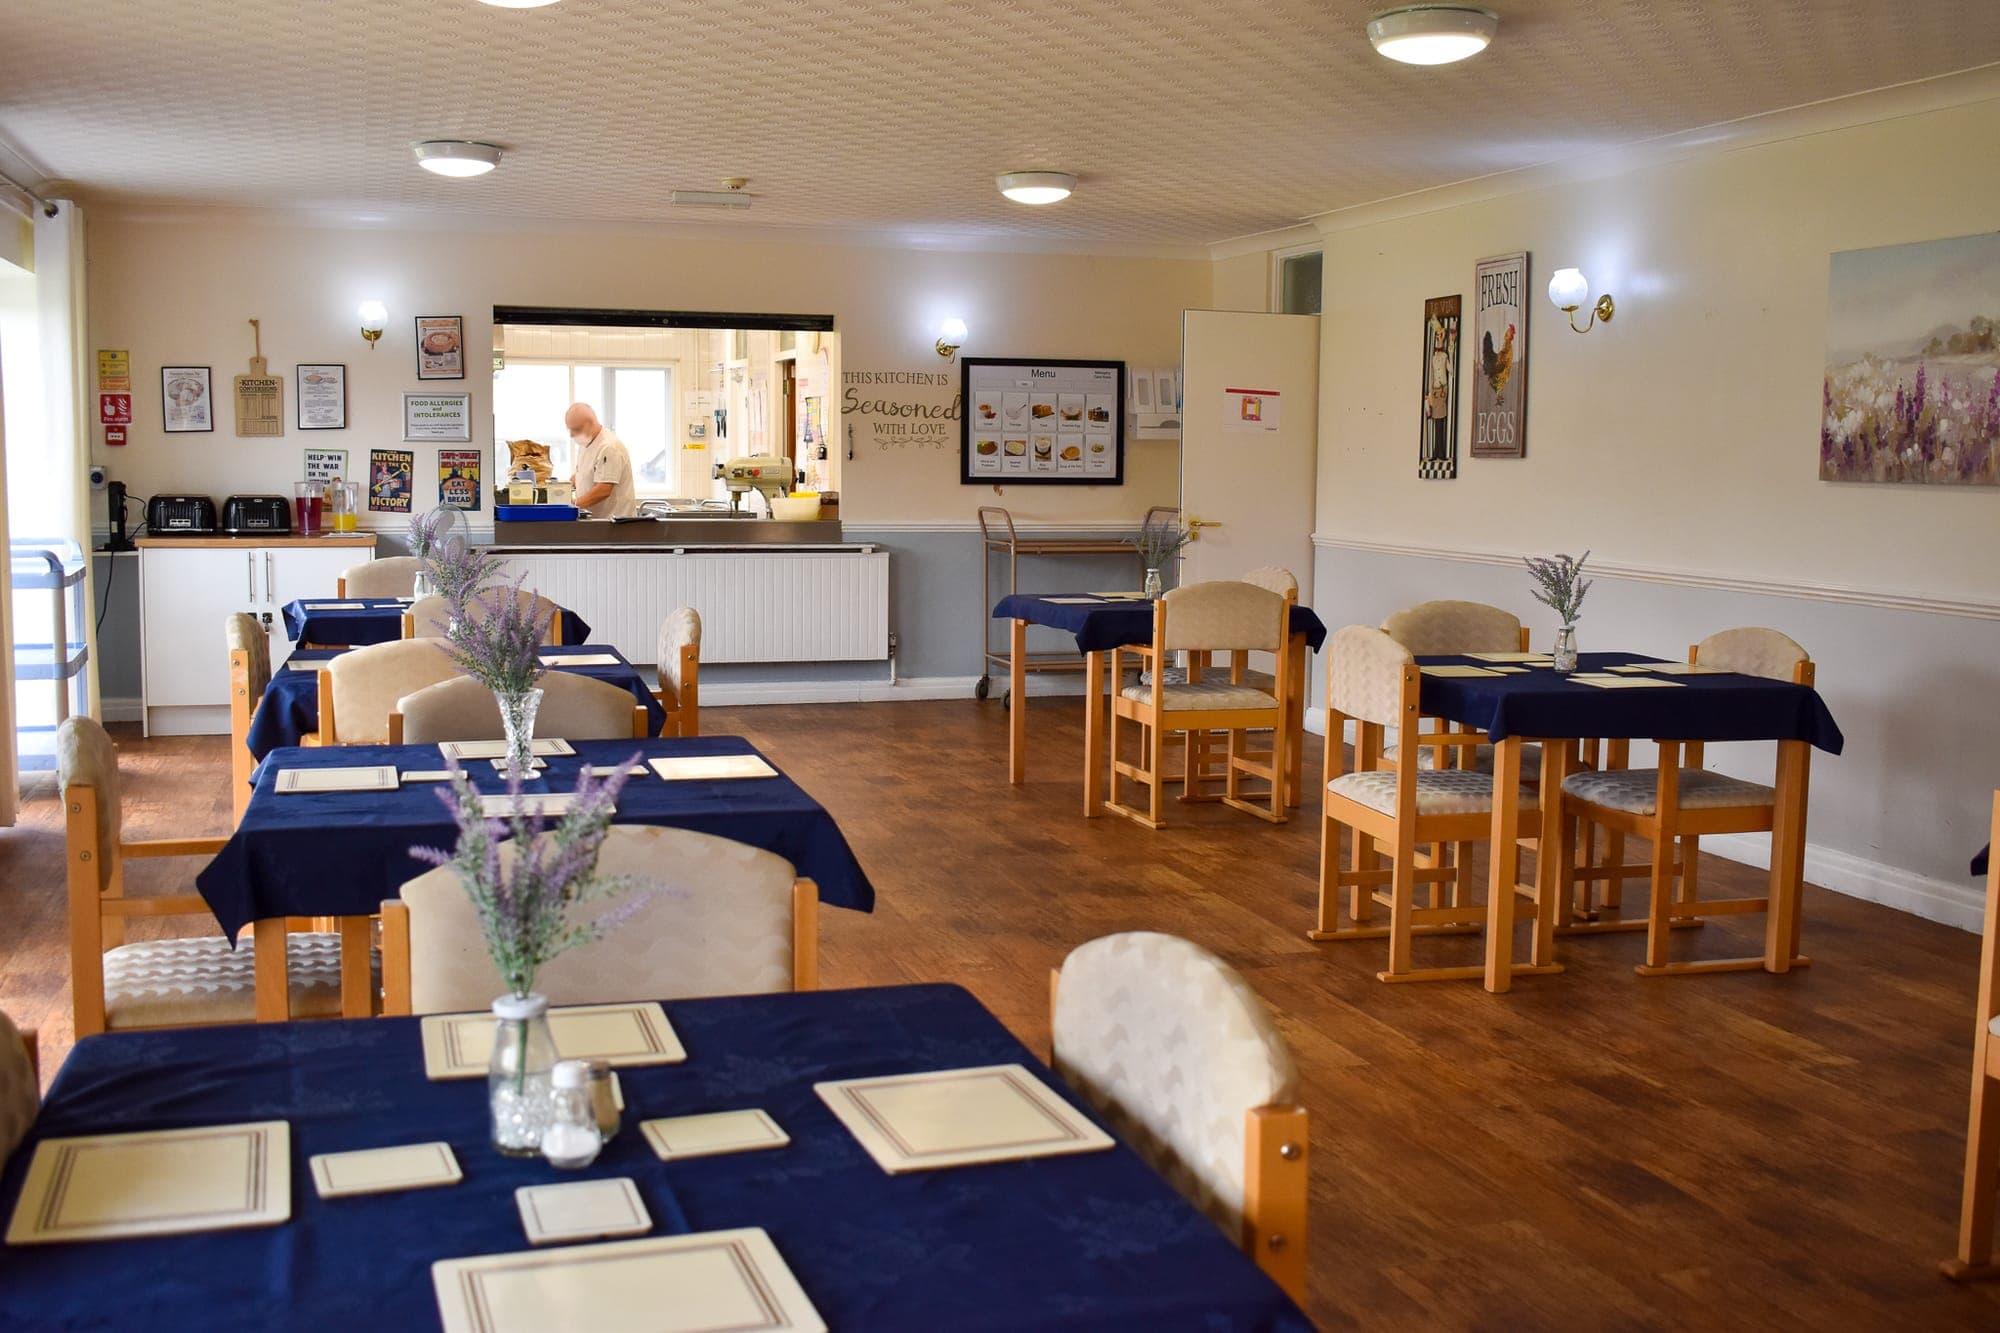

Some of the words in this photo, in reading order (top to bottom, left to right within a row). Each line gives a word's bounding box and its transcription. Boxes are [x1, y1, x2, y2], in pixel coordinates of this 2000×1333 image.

[1480, 270, 1518, 312] FRESH
[843, 371, 872, 385] THIS
[874, 371, 934, 386] KITCHEN
[936, 374, 948, 386] IS
[1031, 369, 1056, 378] Menu
[841, 387, 961, 421] Seasoned
[873, 422, 906, 435] WITH
[911, 423, 946, 435] LOVE
[1477, 411, 1515, 444] EGGS
[307, 453, 324, 461] HELP
[371, 452, 412, 462] KITCHEN
[370, 497, 408, 506] VICTORY
